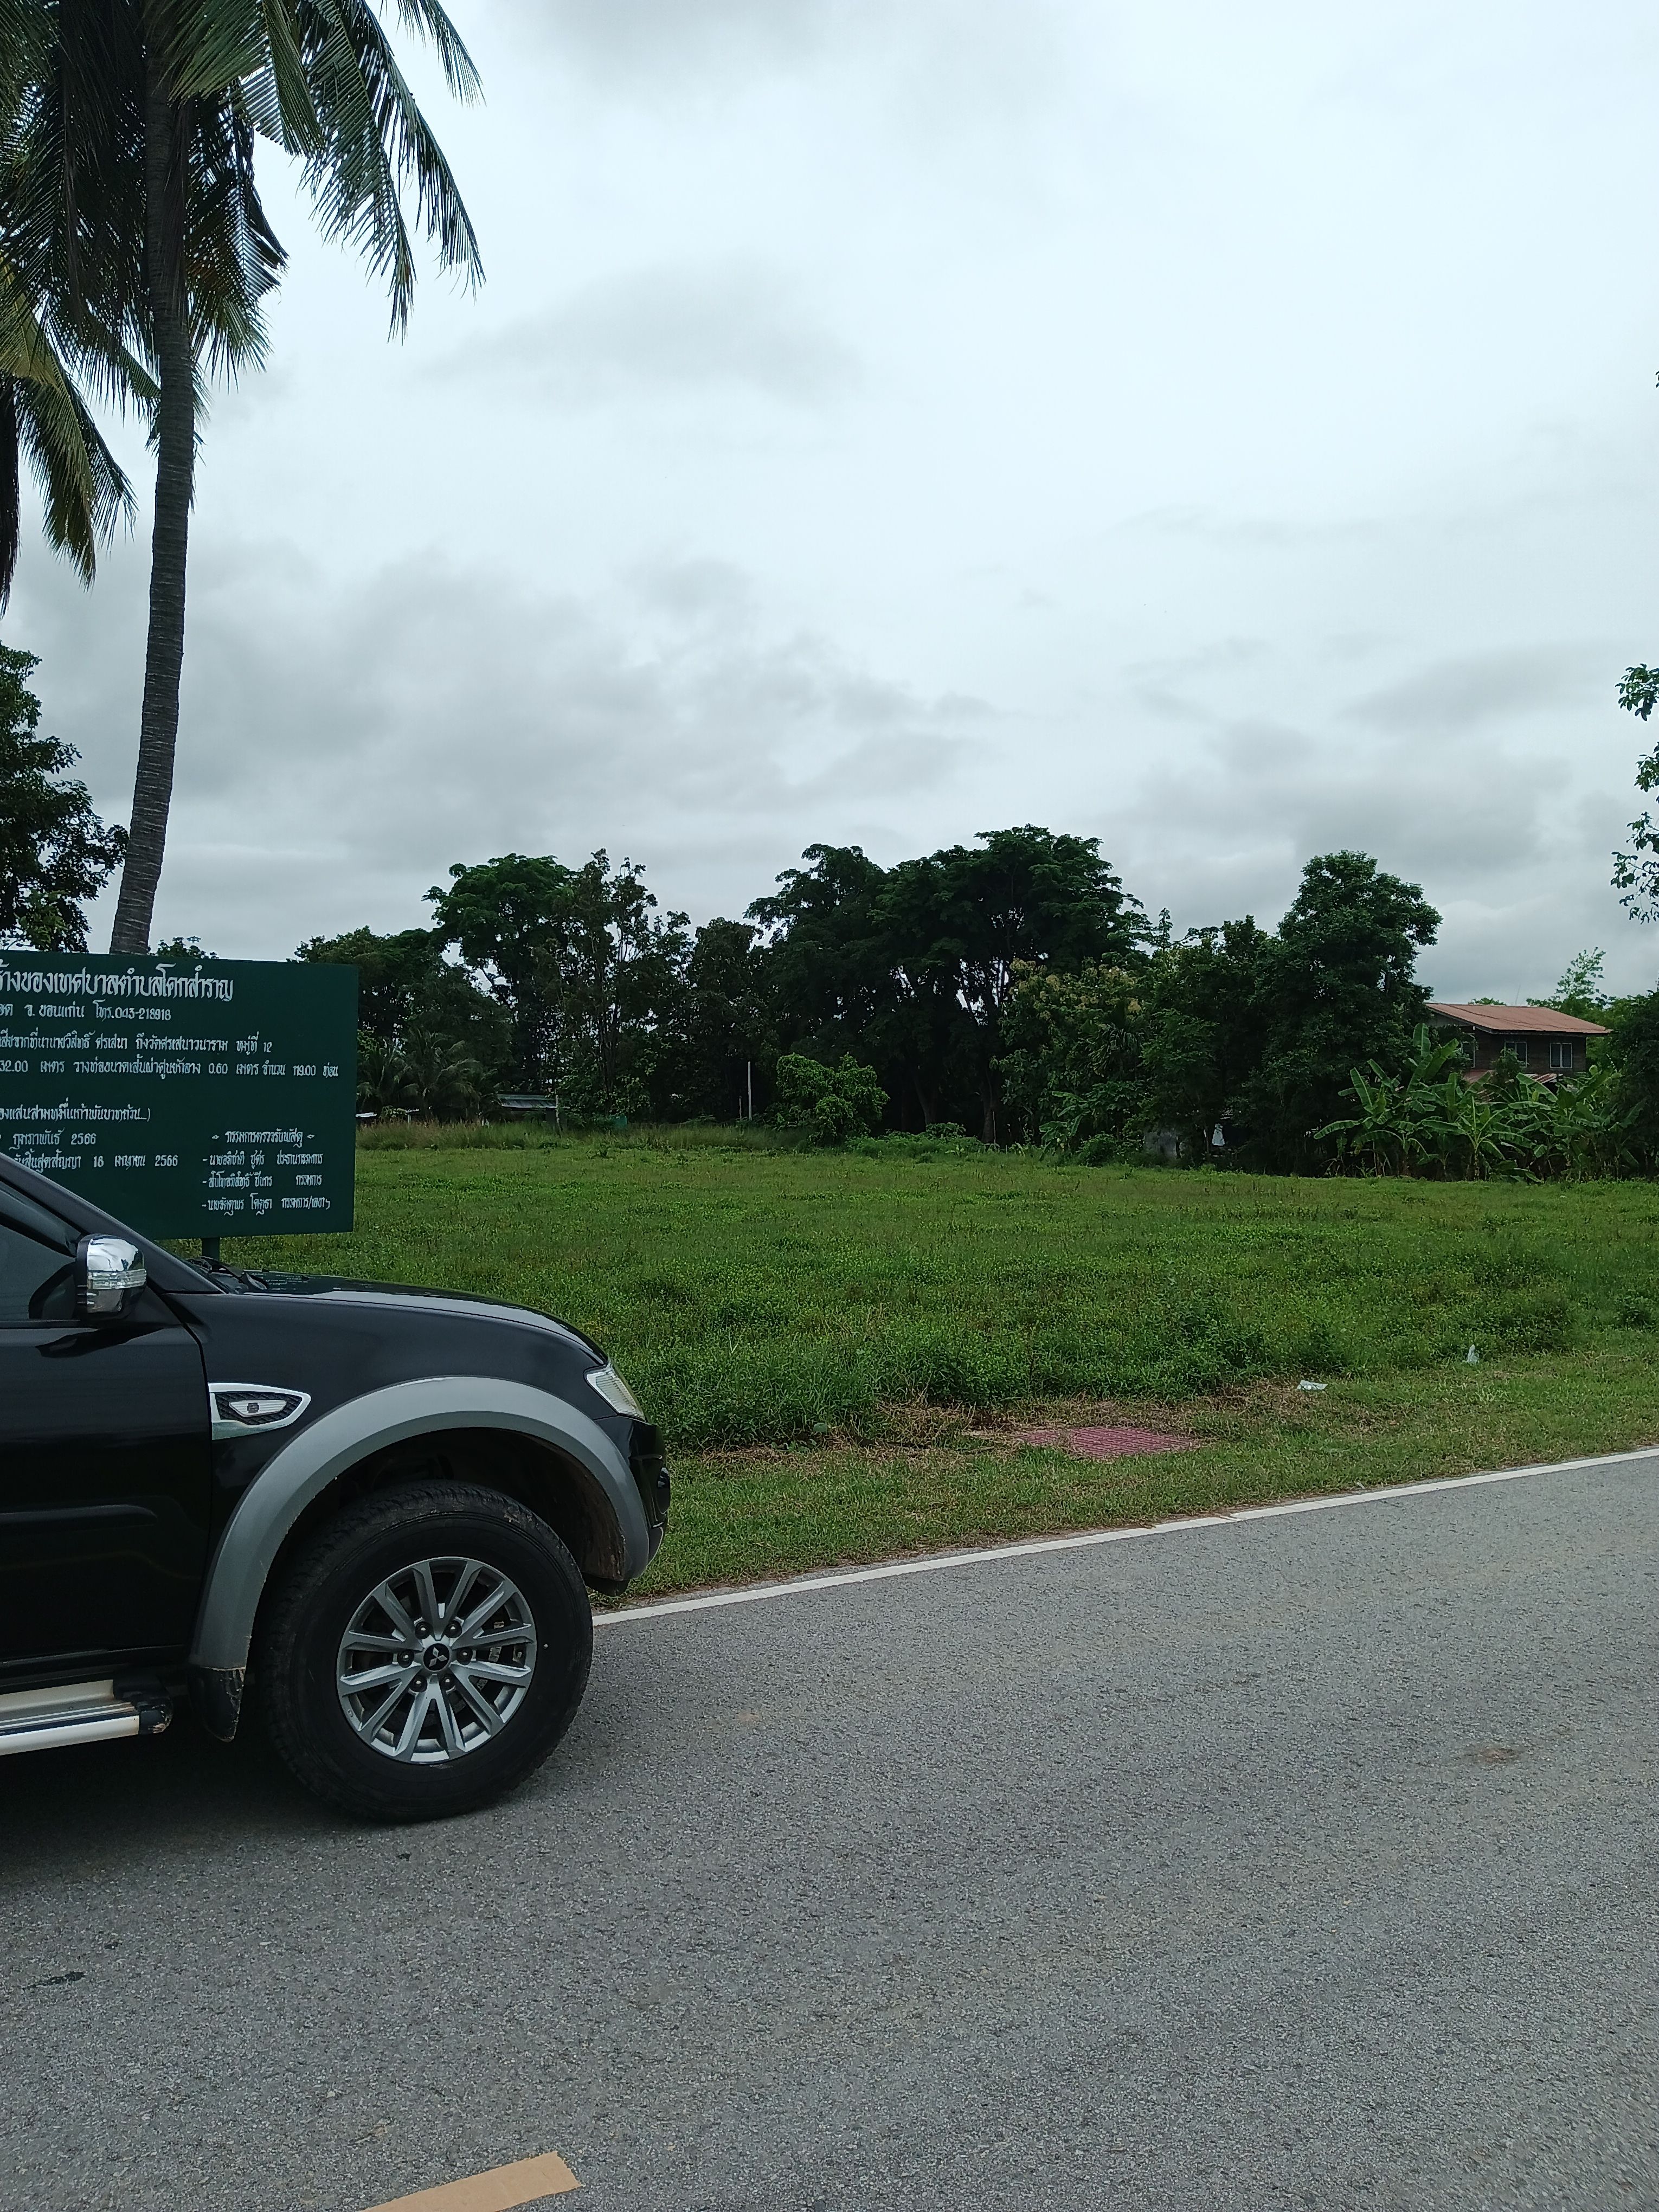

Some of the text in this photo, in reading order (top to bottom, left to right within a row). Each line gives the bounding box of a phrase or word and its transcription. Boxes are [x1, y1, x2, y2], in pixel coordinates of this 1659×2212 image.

[38, 1001, 85, 1018] ขอนแก่น
[92, 999, 171, 1021] โทร.043-218918
[236, 1031, 259, 1056] หมู่ที่
[263, 1041, 273, 1053] 12
[40, 1060, 65, 1073] เมตร
[208, 1063, 228, 1075] 0.60
[236, 1063, 260, 1076] เมตร
[261, 1059, 286, 1076] จำนวน
[70, 1133, 97, 1145] 2566
[14, 1147, 82, 1173] ัสิ้นสุดสัญญา
[93, 1155, 104, 1168] 18
[155, 1155, 178, 1167] 2566
